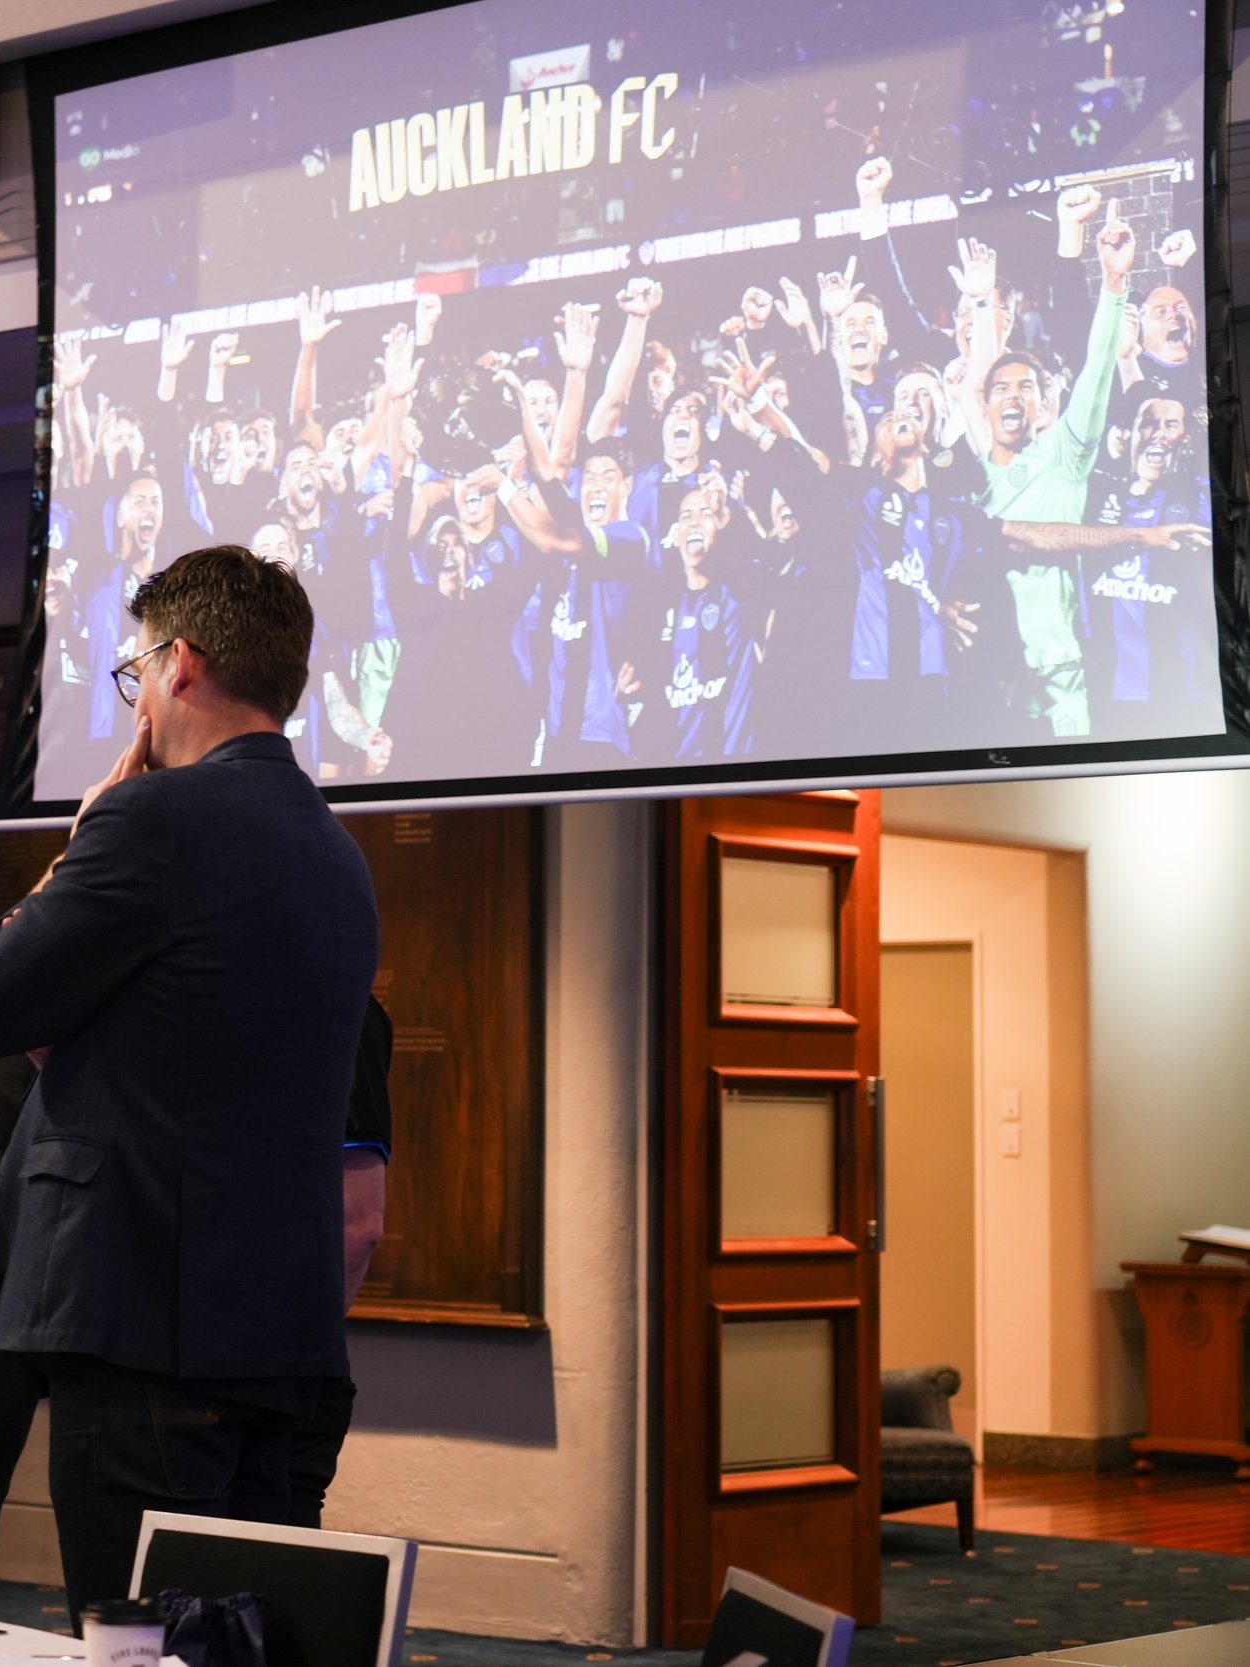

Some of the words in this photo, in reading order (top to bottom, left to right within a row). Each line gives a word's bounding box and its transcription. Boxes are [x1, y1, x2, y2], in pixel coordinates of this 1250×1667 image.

[348, 83, 598, 212] AUCKLAND
[608, 72, 679, 165] FC
[1091, 571, 1178, 605] Anchor
